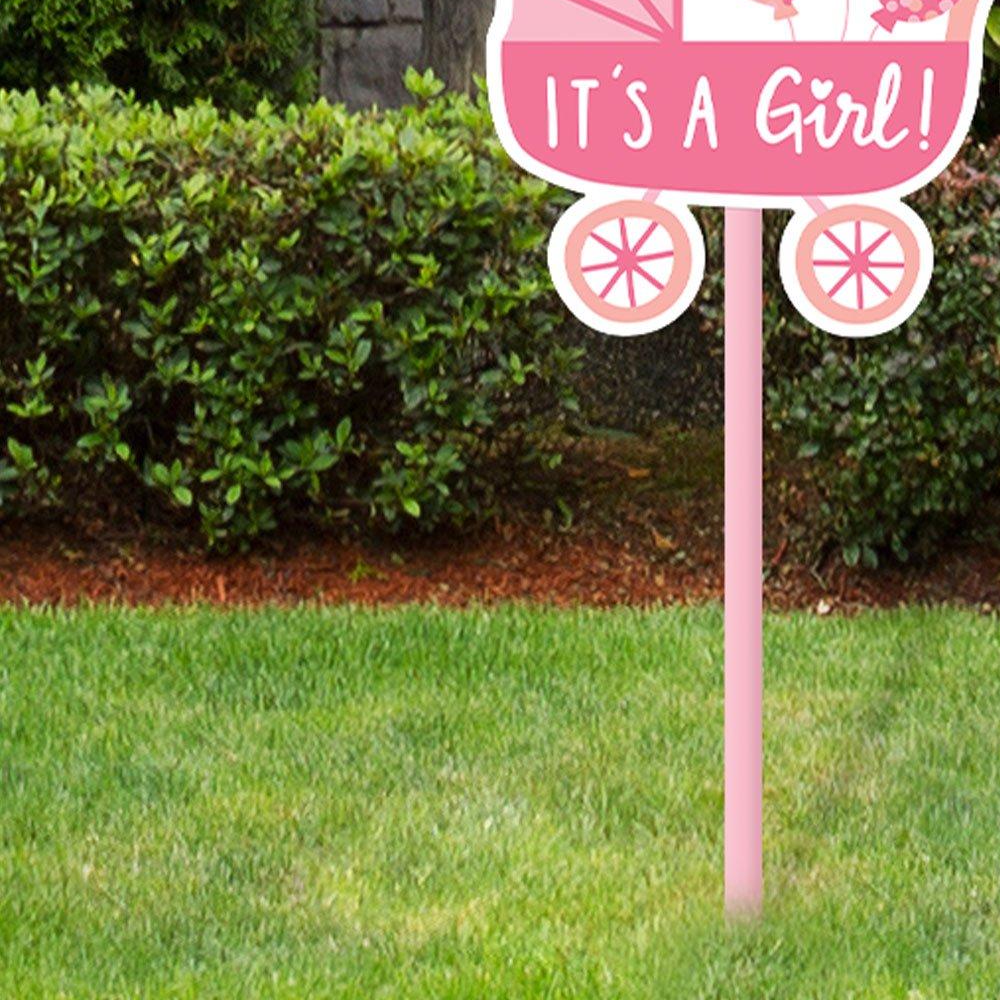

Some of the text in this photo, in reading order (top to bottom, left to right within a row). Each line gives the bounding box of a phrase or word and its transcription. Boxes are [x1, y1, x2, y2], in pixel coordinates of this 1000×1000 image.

[546, 62, 935, 154] IT'S A Girl!
